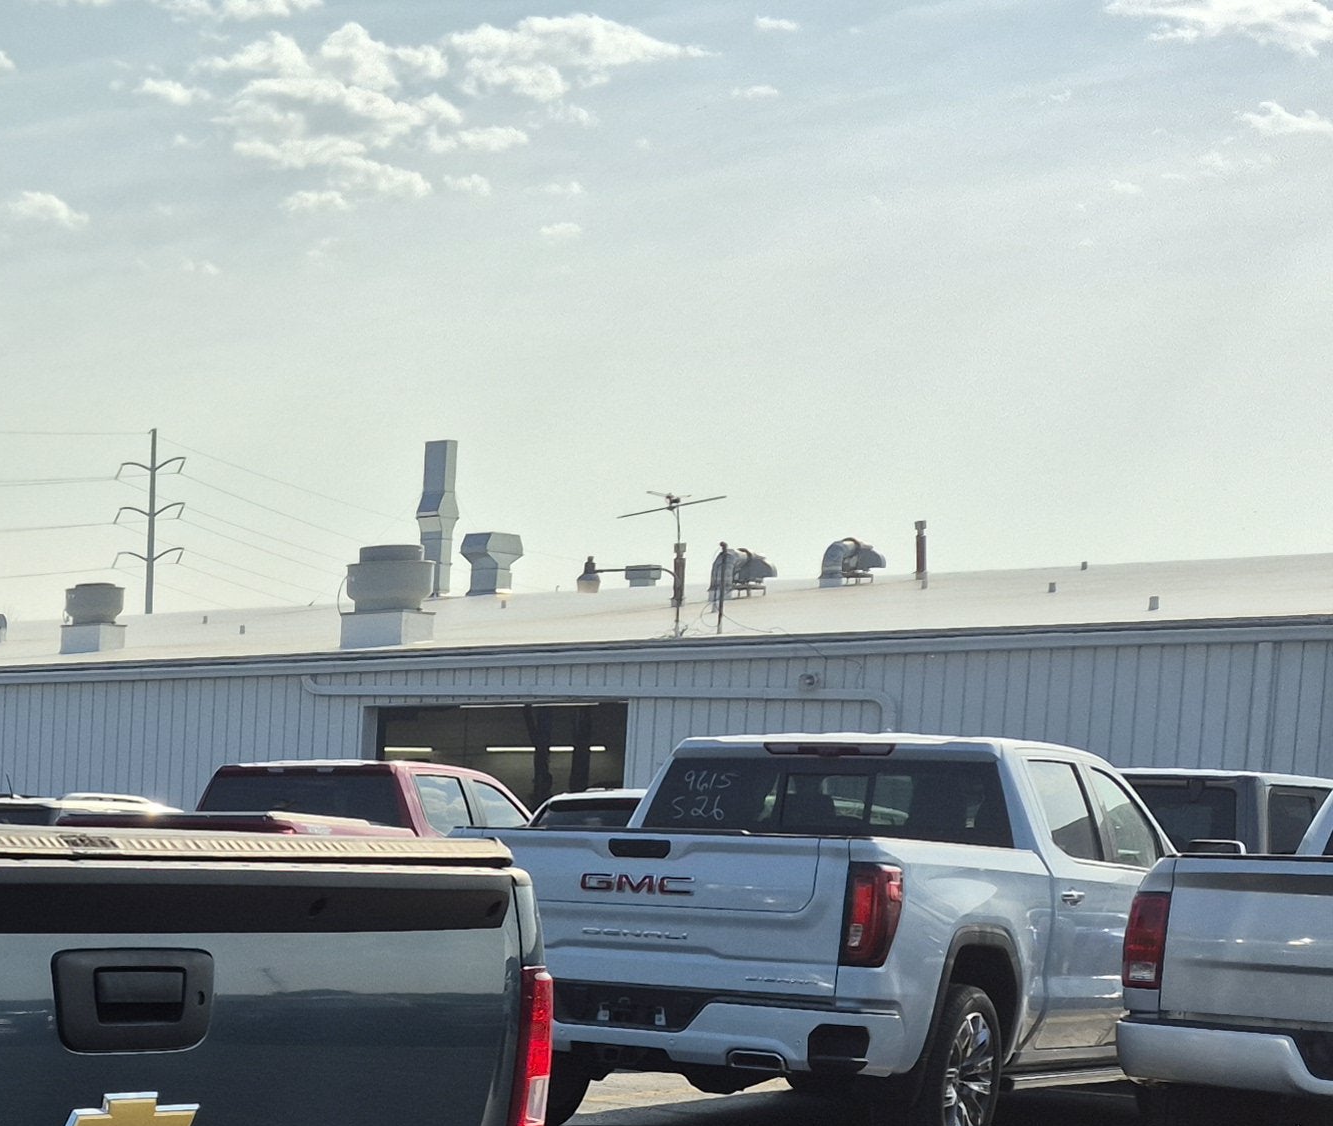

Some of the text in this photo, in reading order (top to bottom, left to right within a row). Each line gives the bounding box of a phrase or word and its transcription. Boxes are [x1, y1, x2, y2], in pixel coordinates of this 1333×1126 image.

[684, 770, 740, 792] 9615
[580, 872, 695, 896] GMC
[582, 926, 688, 940] DENALI
